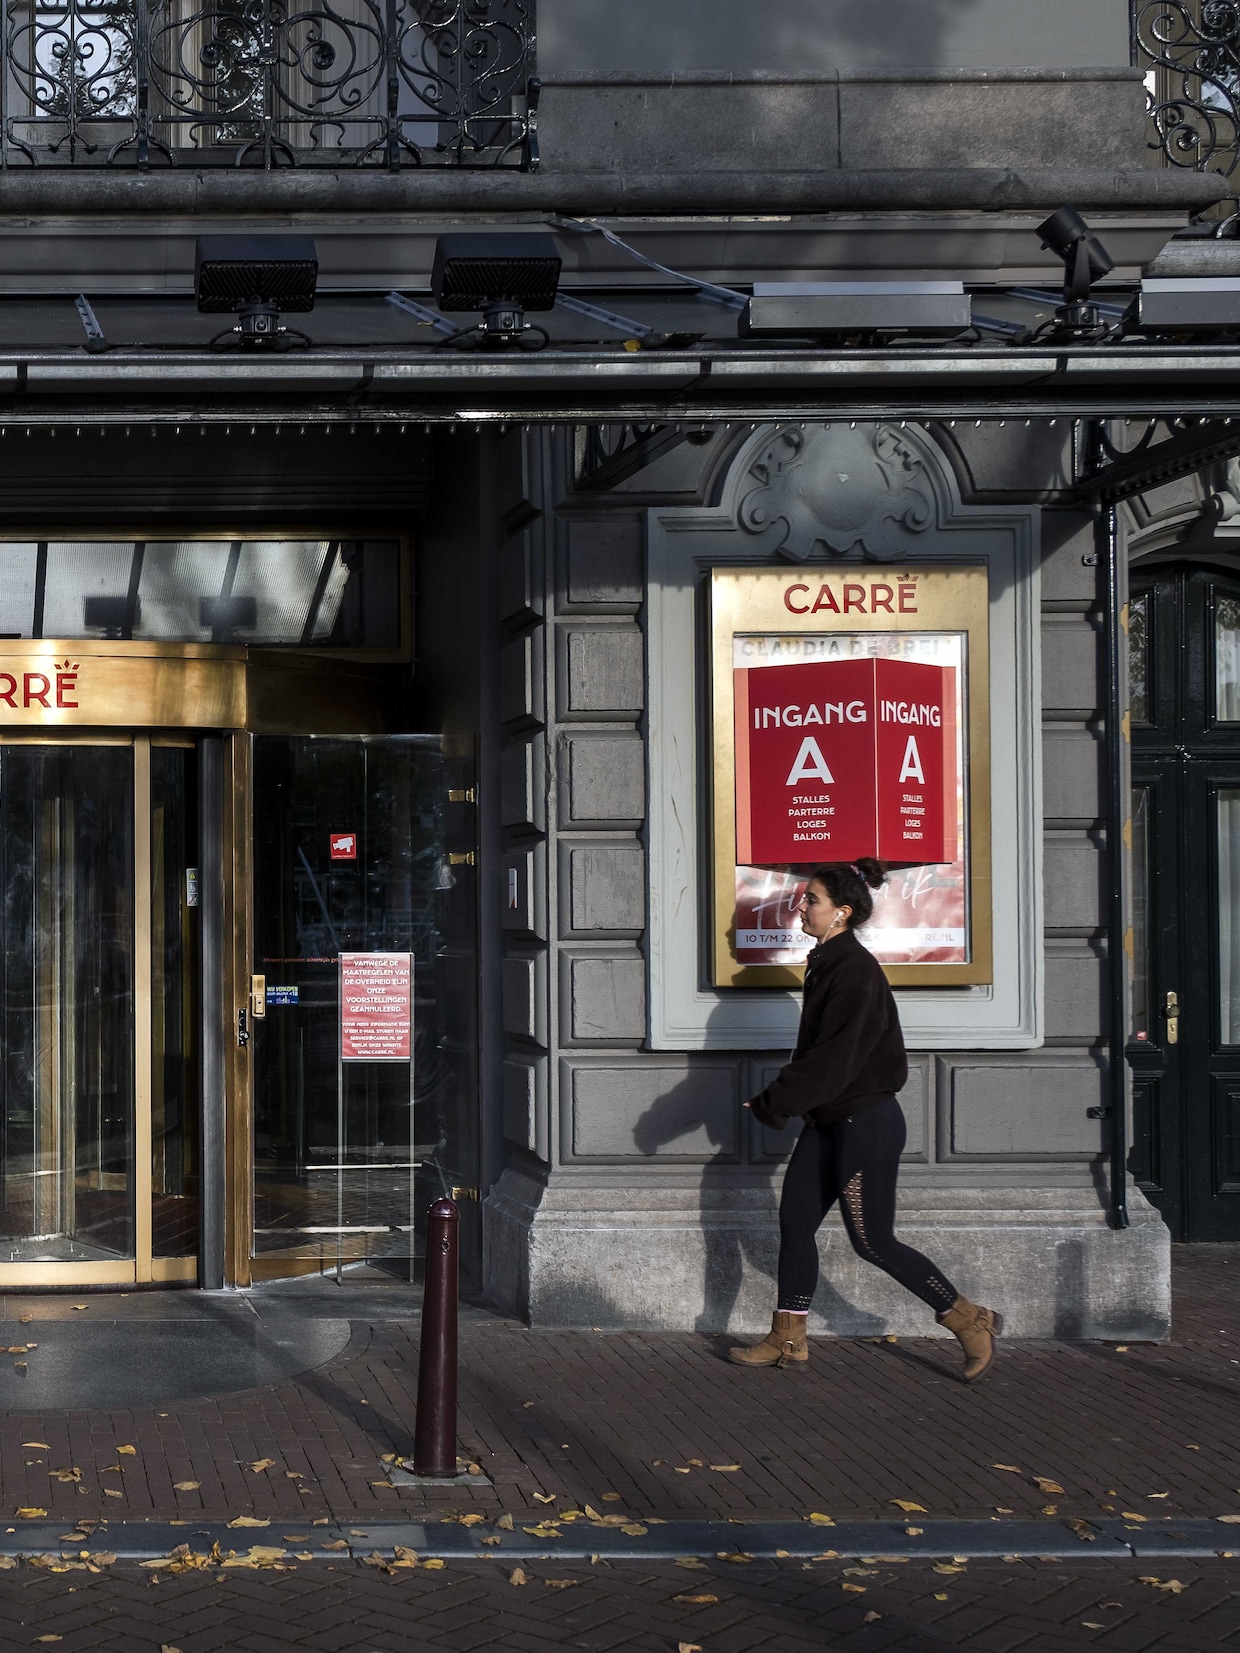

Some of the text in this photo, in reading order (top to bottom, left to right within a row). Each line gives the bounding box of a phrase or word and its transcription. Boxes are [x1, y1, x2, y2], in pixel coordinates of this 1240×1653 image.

[741, 640, 842, 657] CLAUDIA
[850, 640, 878, 656] DE
[754, 700, 867, 729] INGANG
[880, 700, 941, 727] INGANG
[785, 736, 835, 786] A
[899, 735, 925, 784] A
[792, 795, 830, 804] STALLES
[902, 794, 923, 802] STALLES
[788, 807, 835, 816] PARTERRE
[900, 806, 925, 815] PARTERRE
[797, 820, 827, 828] LOGES
[904, 819, 921, 827] LOGES
[793, 832, 831, 841] BALKON
[903, 831, 923, 839] BALKON
[744, 934, 757, 943] 10
[759, 934, 778, 943] T/M
[781, 934, 793, 943] 22
